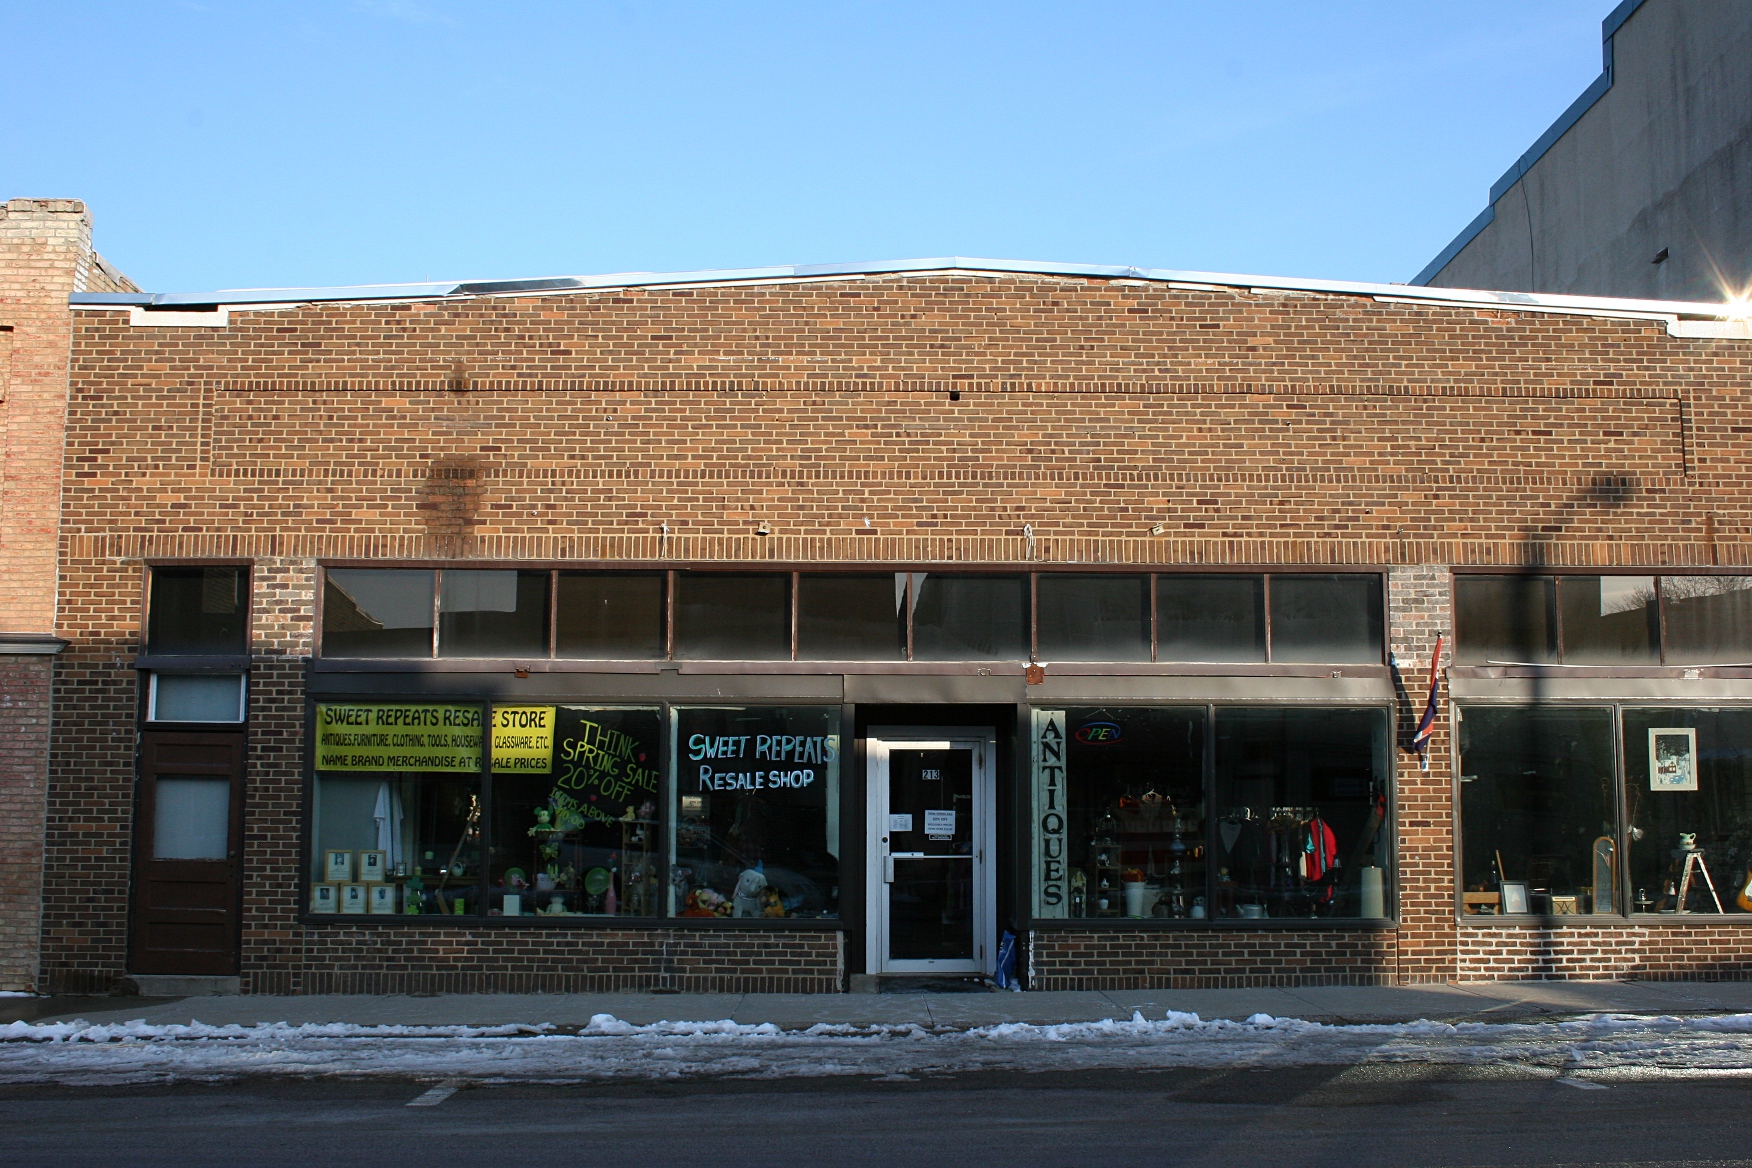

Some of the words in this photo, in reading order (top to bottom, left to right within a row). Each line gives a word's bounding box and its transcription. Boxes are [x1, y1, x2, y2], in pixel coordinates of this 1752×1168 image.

[324, 707, 373, 725] SWEET
[376, 708, 439, 726] REPEATS
[443, 709, 497, 728] RESAE
[501, 710, 547, 728] STORE
[392, 734, 426, 748] CLOTHING,
[428, 734, 450, 748] TOOLS,
[535, 736, 550, 749] ETC.
[580, 719, 640, 763] THINK
[688, 733, 750, 761] SWEET
[756, 734, 838, 765] REPEATS
[1076, 726, 1121, 743] OPEN
[322, 755, 348, 766] NAME
[351, 755, 385, 766] BRAND
[387, 756, 456, 767] MERCHANDISE
[459, 756, 473, 767] AT
[513, 757, 547, 769] PRICES
[560, 738, 620, 776] SPRING
[622, 763, 660, 793] SALE
[923, 770, 939, 779] 213
[557, 763, 599, 791] 20%
[600, 775, 635, 803] OFF
[699, 765, 764, 792] RESALE
[768, 769, 815, 788] SHOP
[549, 787, 579, 809] ITEMS
[578, 803, 615, 828] ABOVE
[1041, 718, 1064, 906] ANTIQUES
